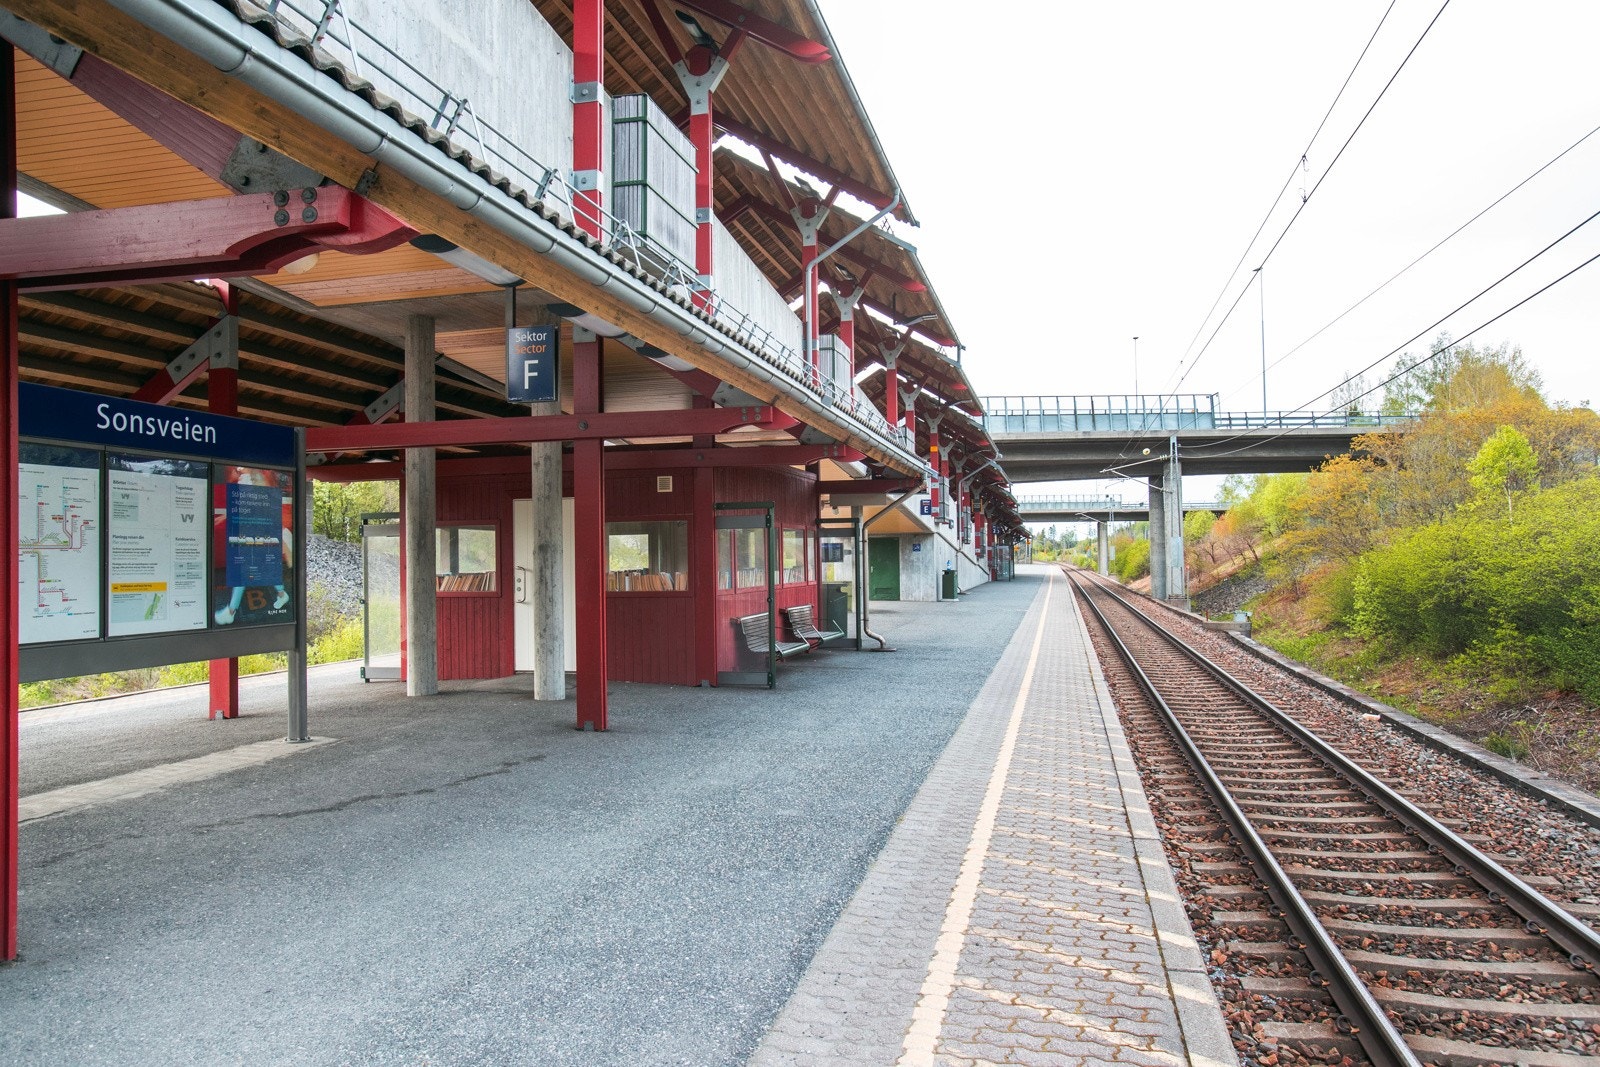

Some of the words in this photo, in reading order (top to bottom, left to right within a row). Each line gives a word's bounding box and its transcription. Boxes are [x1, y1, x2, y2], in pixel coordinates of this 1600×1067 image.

[515, 331, 548, 342] Sektor
[514, 344, 546, 354] Sector
[524, 360, 538, 390] F
[96, 403, 216, 444] Sonsveien
[246, 588, 267, 610] B
